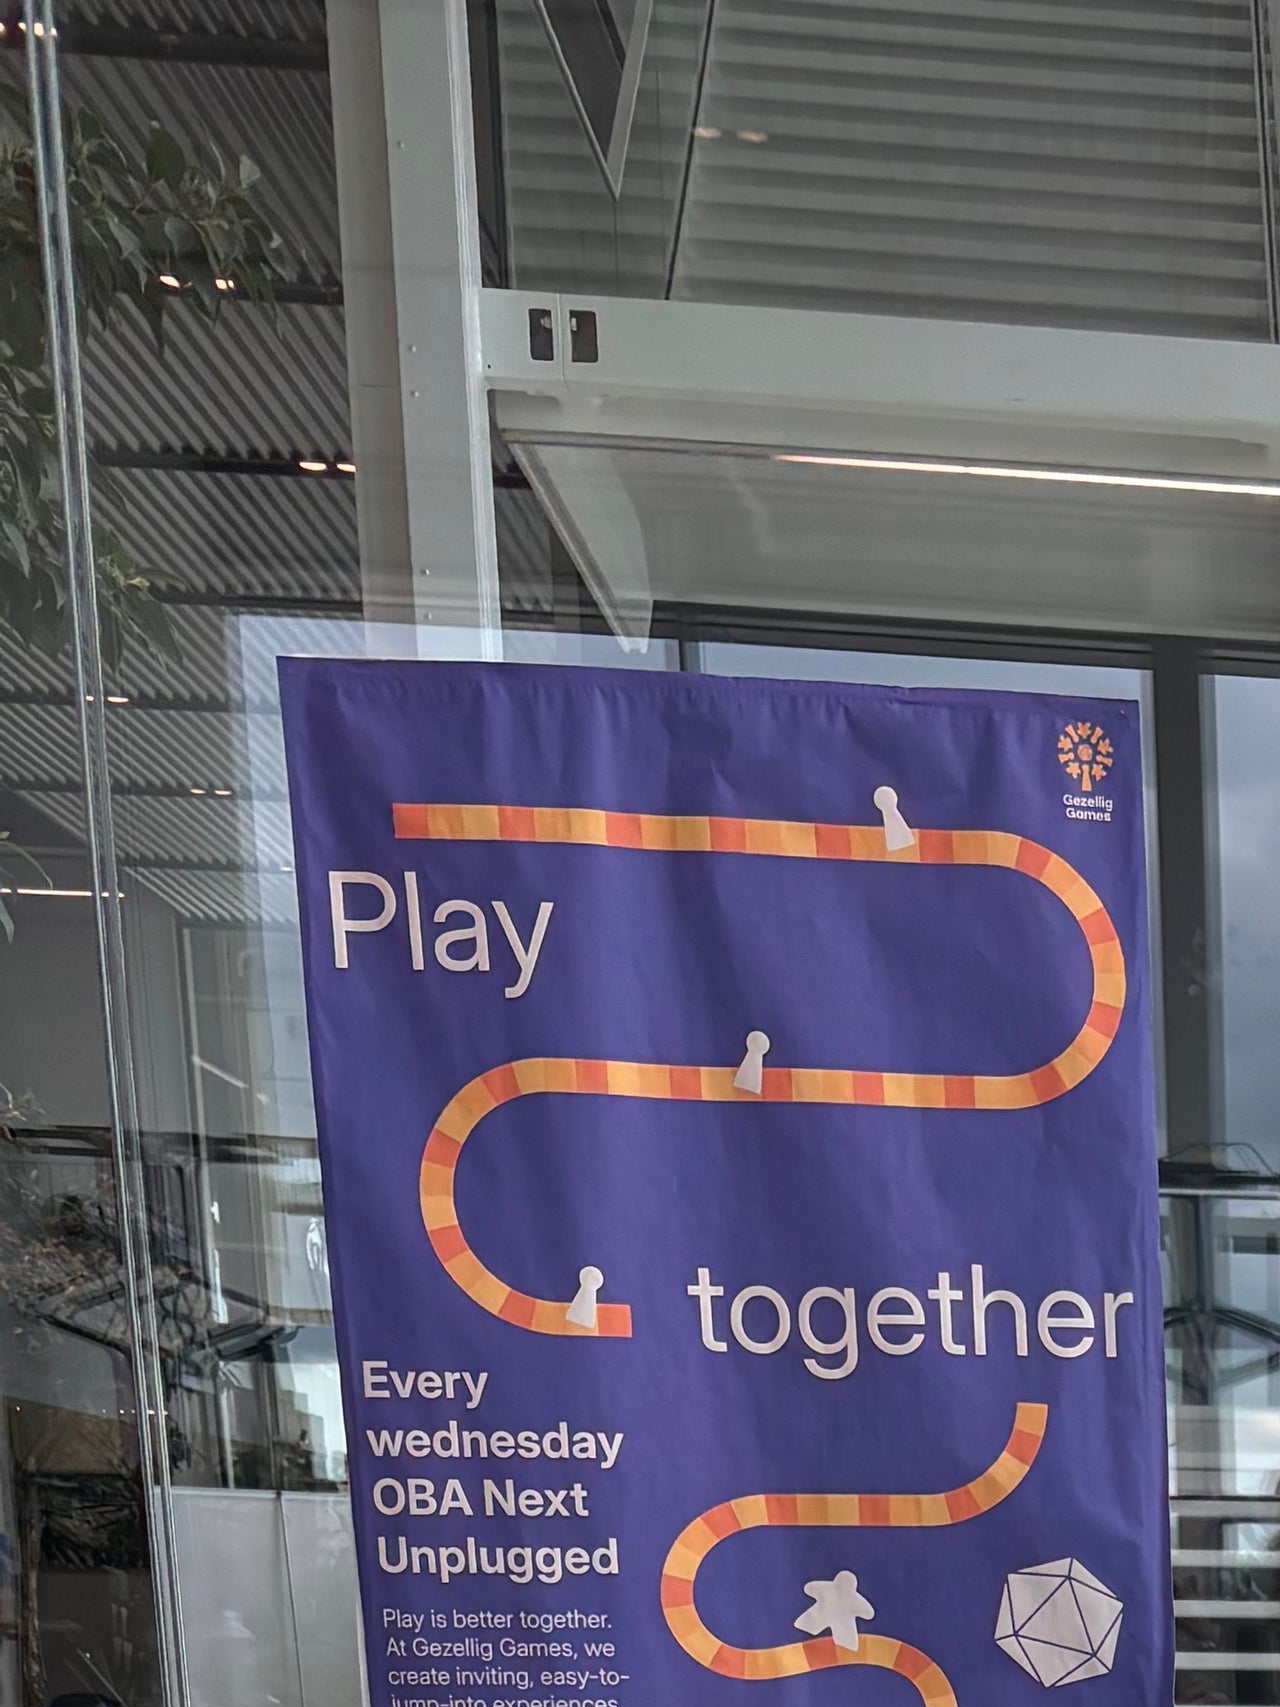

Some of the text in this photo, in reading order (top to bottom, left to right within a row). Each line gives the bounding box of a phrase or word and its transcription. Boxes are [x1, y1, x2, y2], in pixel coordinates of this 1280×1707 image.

[1063, 794, 1113, 811] Gezellig
[1066, 808, 1111, 821] Games
[328, 870, 555, 999] Play
[686, 1263, 1135, 1380] together
[362, 1360, 489, 1409] Every
[365, 1419, 625, 1469] wednesday
[373, 1477, 590, 1517] OBA Next
[377, 1536, 620, 1584] Unplugged
[382, 1608, 612, 1634] Play is better together.
[386, 1636, 616, 1662] At Gezellig Games, we
[388, 1666, 630, 1690] create inviting, easy-to-
